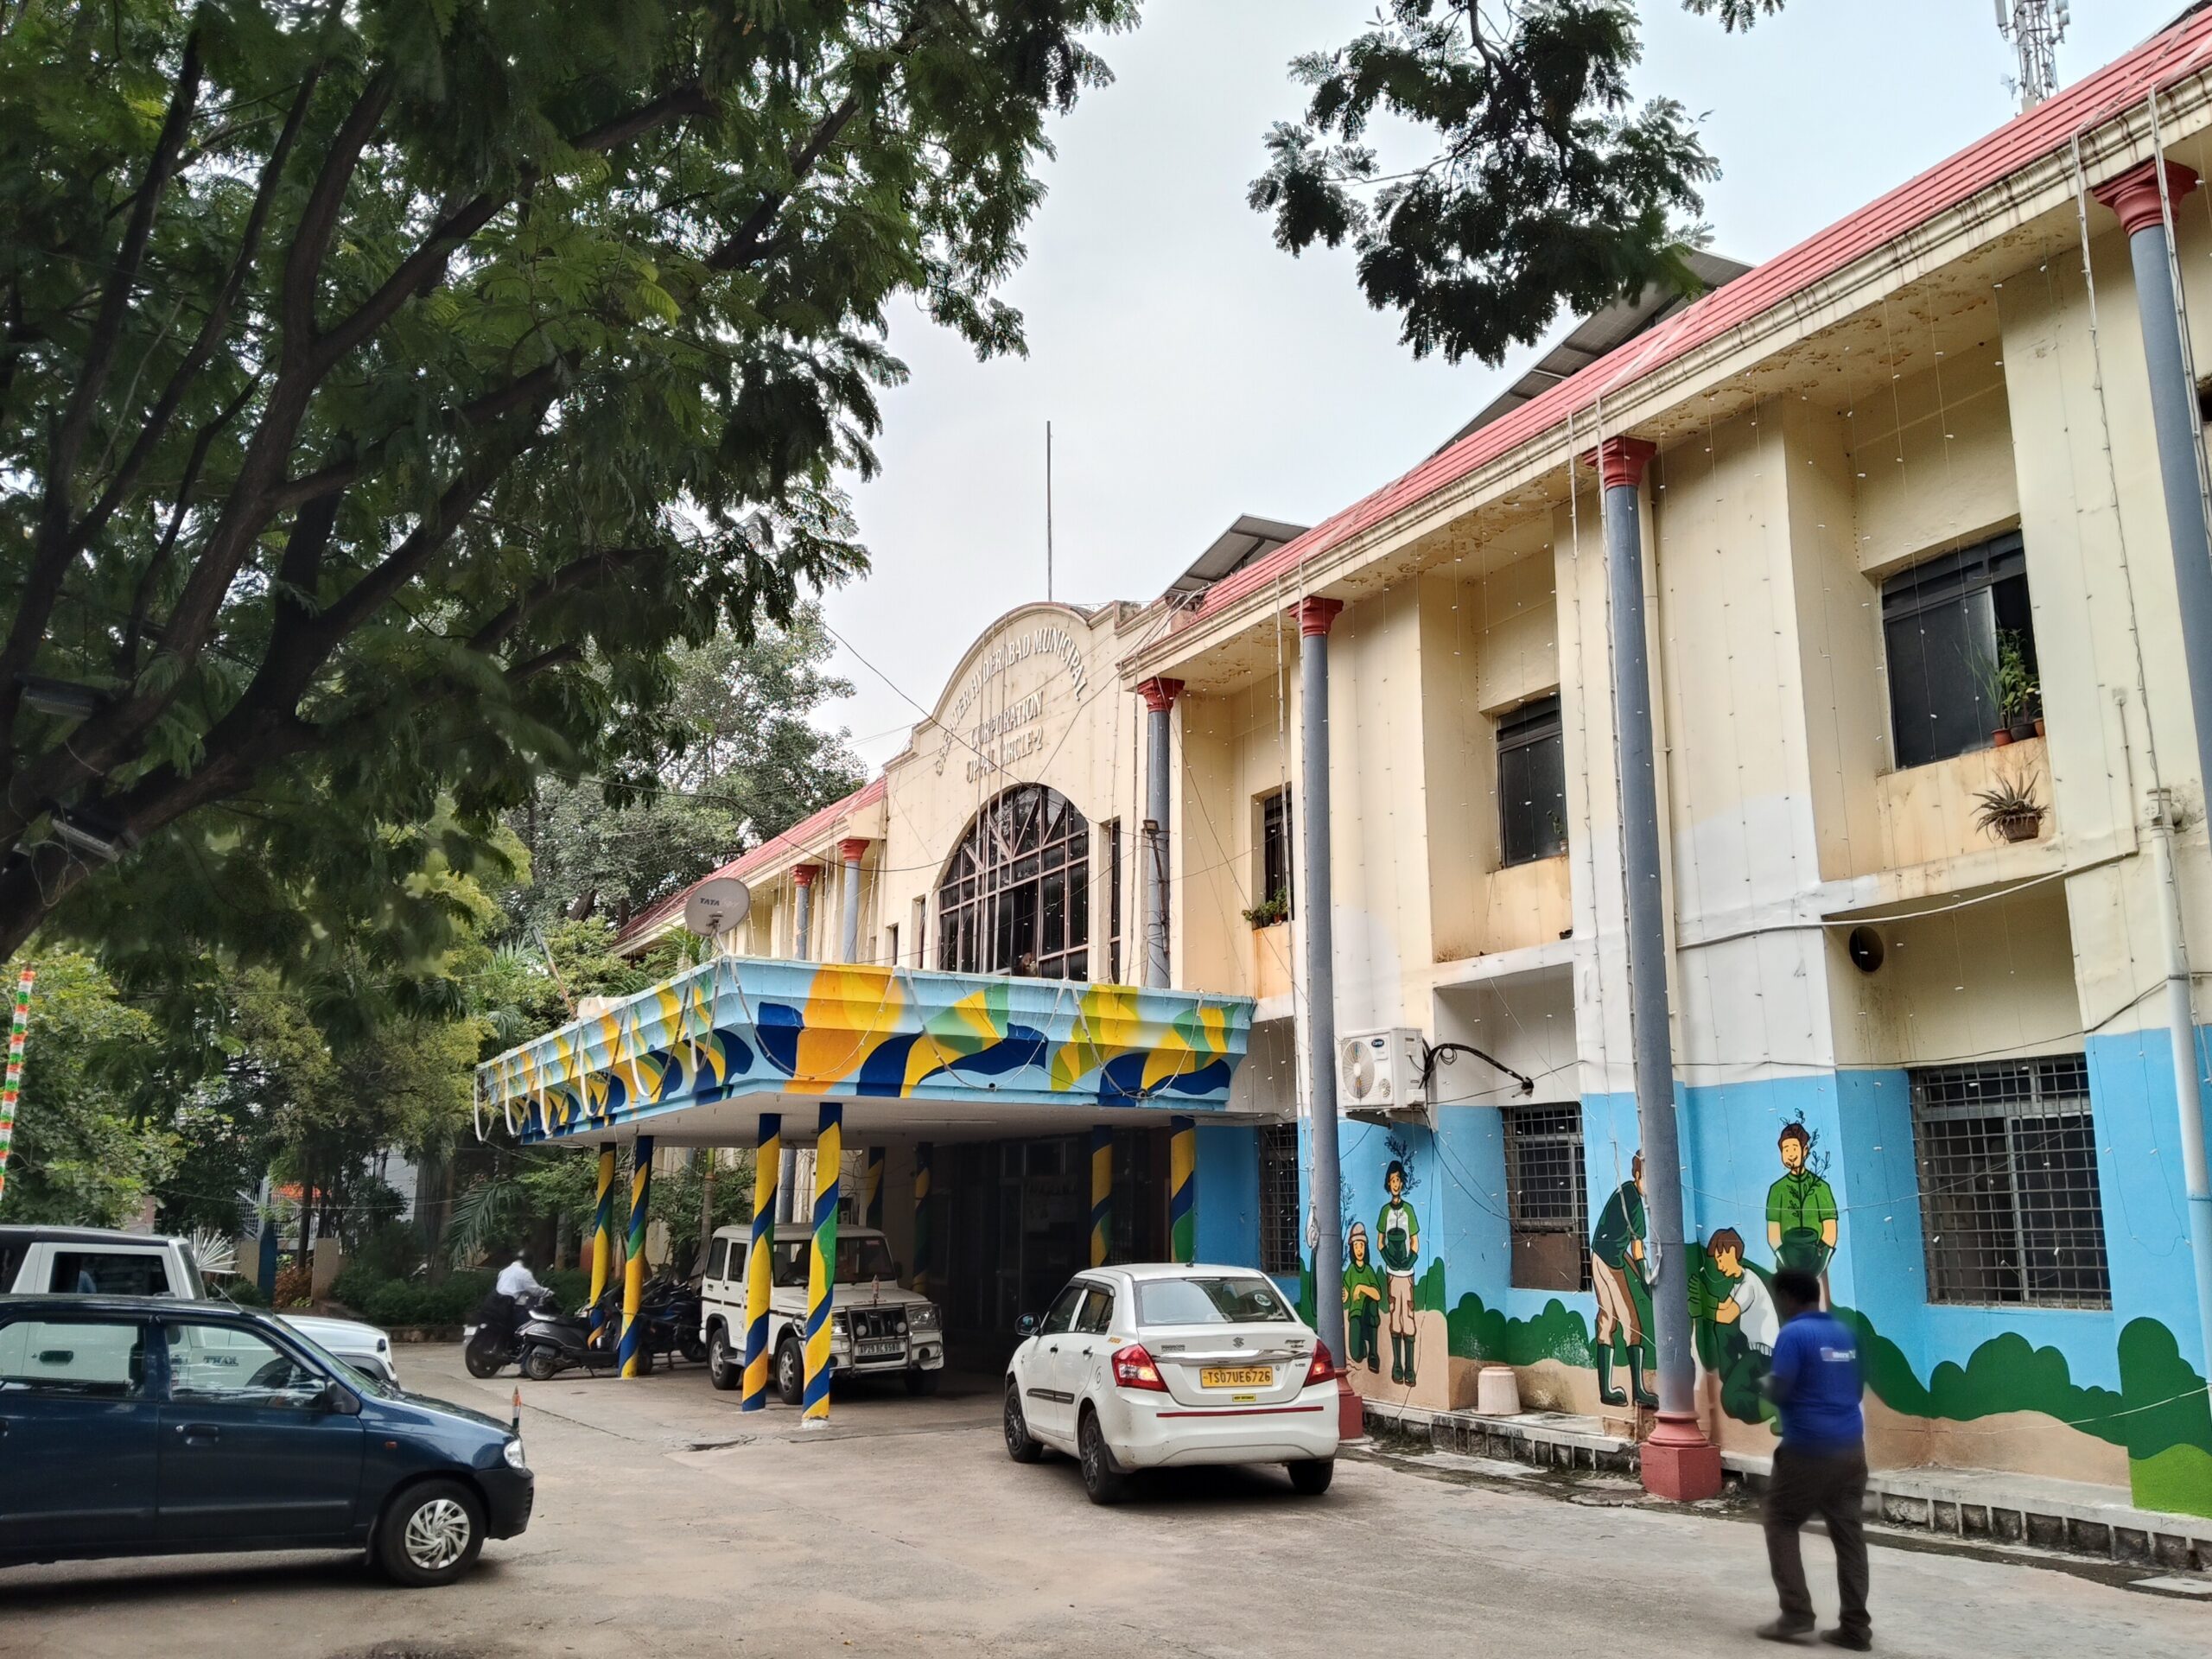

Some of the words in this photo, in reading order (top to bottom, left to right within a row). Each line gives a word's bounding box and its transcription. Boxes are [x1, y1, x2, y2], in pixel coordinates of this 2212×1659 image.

[970, 634, 1031, 700] HYDERABAD
[1033, 627, 1088, 702] MUNICIPAL
[969, 690, 1044, 751] CORPORATION
[966, 748, 997, 784] UPPAL
[699, 898, 720, 906] TATA
[1207, 1370, 1271, 1384] TS07UE6726
